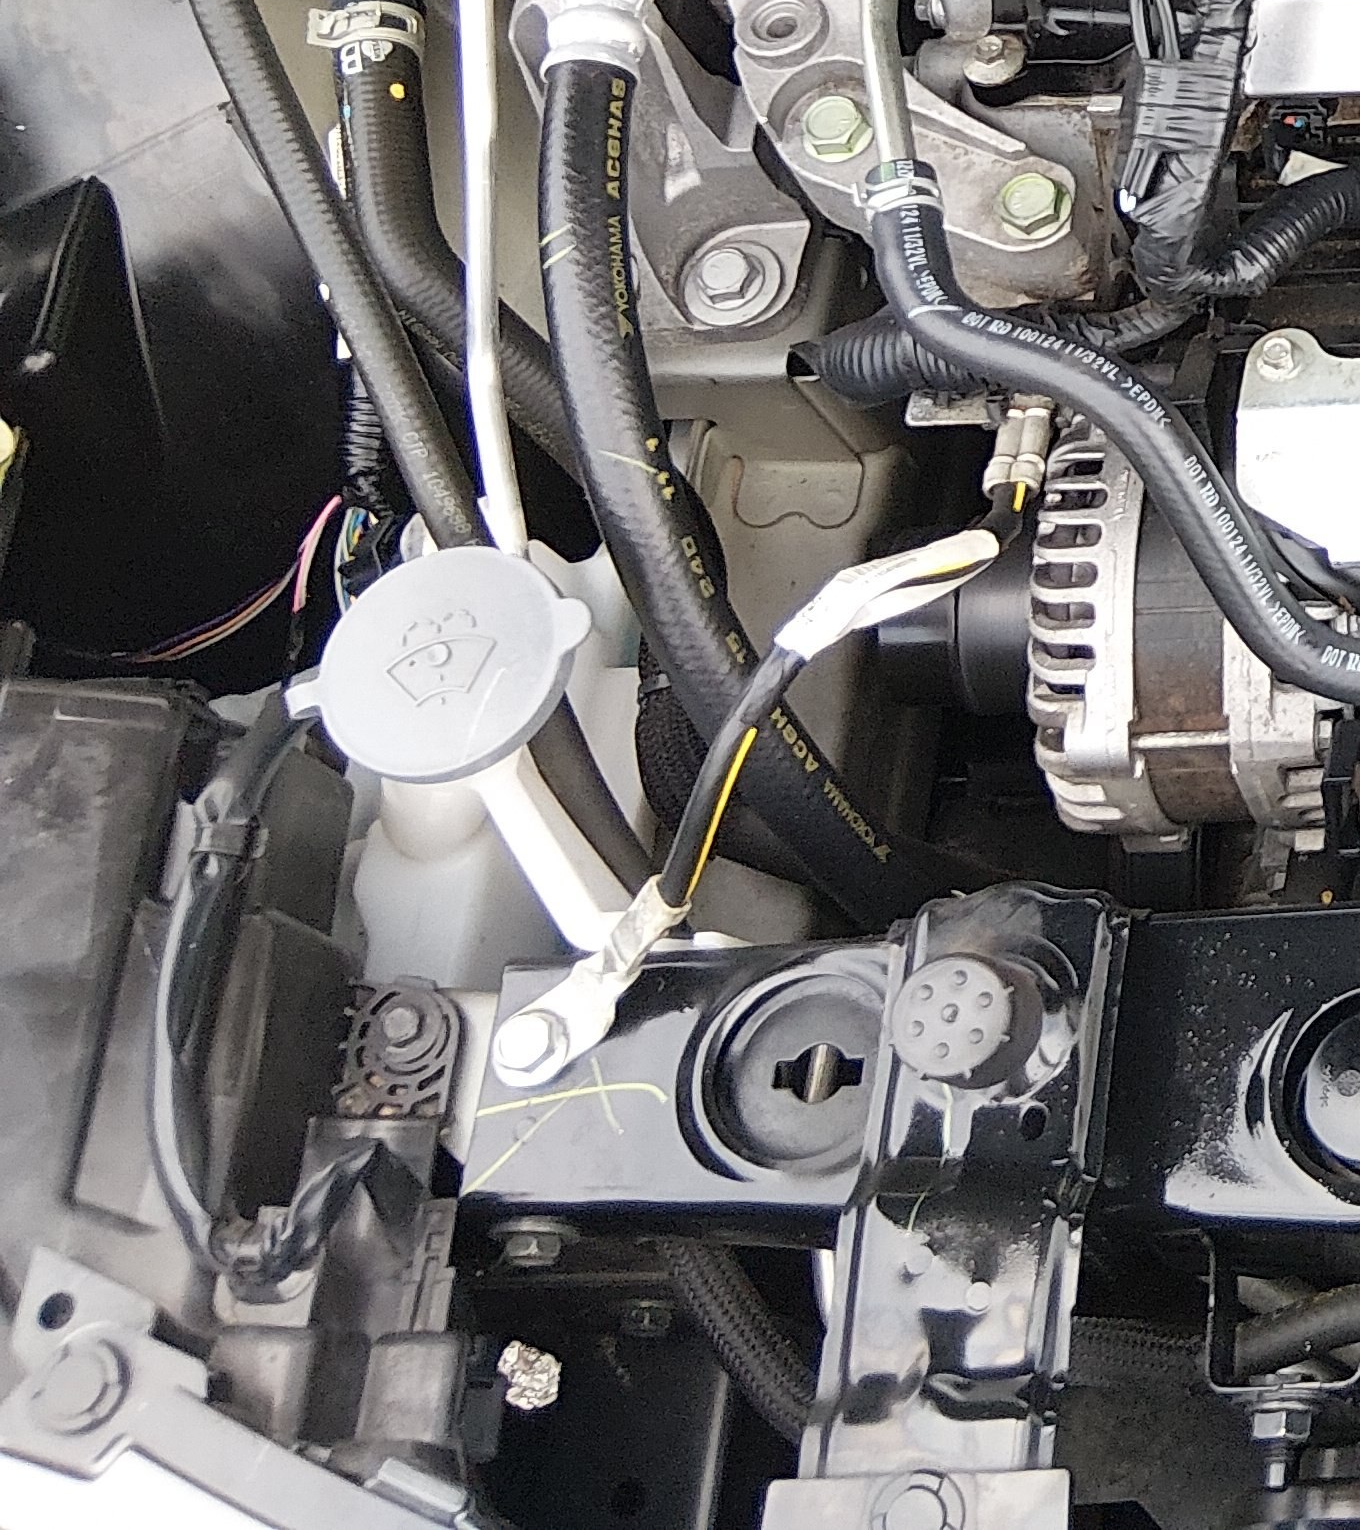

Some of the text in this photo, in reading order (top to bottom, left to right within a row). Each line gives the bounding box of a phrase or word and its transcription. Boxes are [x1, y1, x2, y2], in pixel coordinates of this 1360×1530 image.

[607, 215, 629, 315] YOKOHAMA
[1012, 326, 1066, 351] 100124
[1064, 342, 1121, 382] 11/32VL
[1184, 454, 1208, 483] DOT
[1212, 506, 1249, 556] 100124
[1239, 553, 1275, 607] 11/32VL
[1320, 644, 1348, 669] DOT
